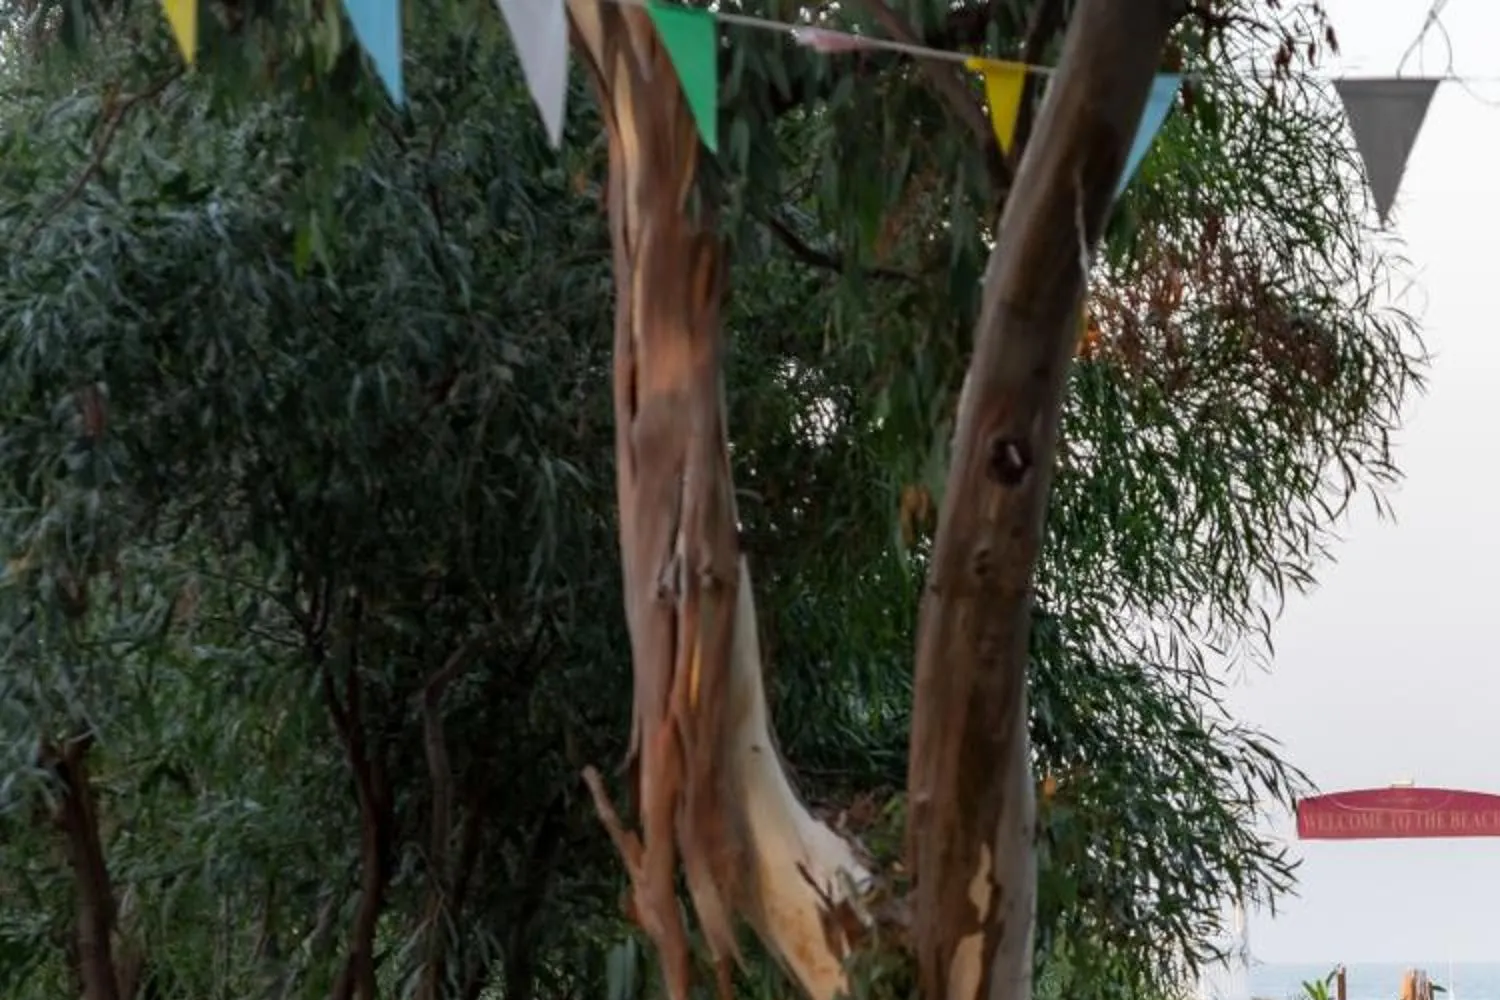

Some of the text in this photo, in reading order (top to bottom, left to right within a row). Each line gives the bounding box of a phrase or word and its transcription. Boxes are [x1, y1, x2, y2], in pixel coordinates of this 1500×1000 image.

[1304, 811, 1384, 832] WELCOME
[1391, 811, 1411, 832] TO
[1416, 810, 1448, 831] THE
